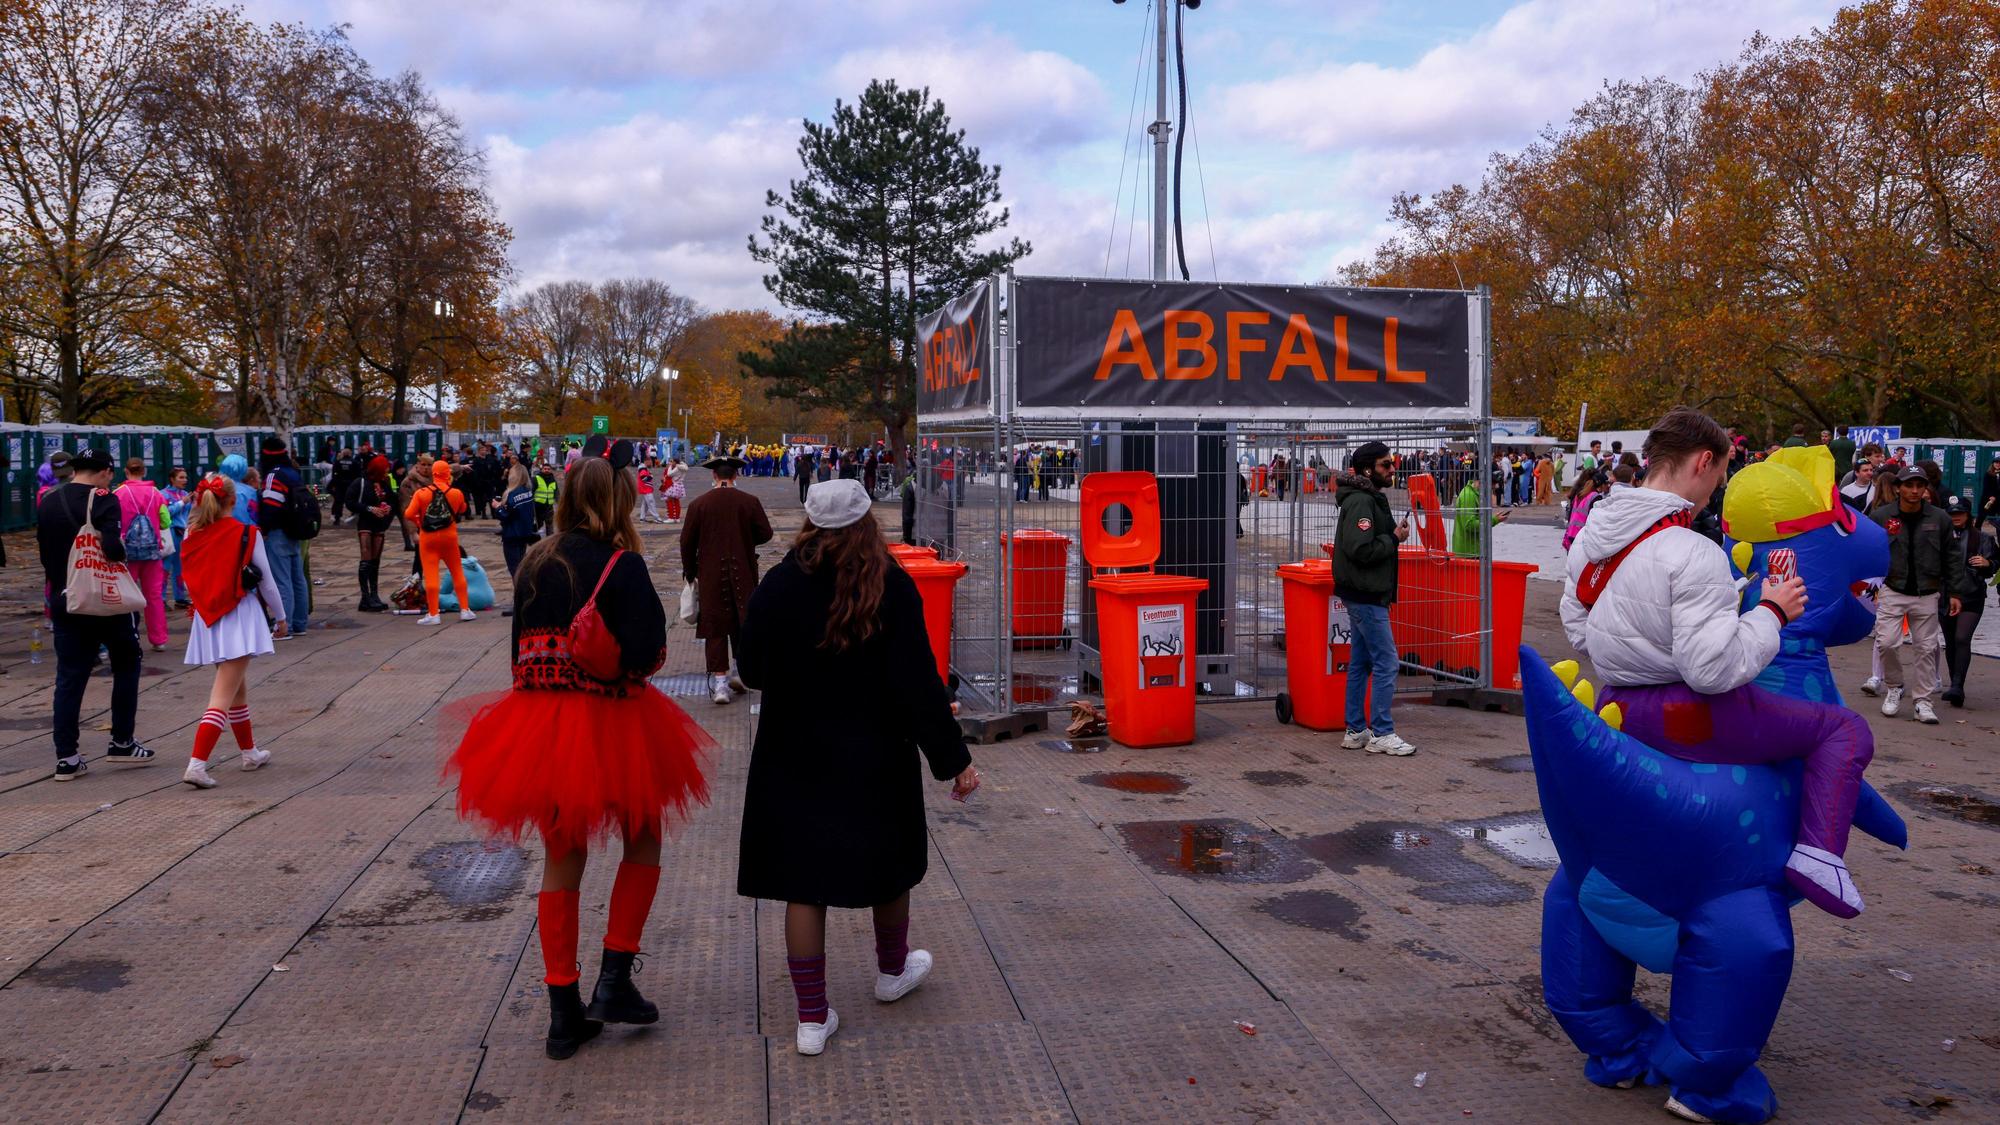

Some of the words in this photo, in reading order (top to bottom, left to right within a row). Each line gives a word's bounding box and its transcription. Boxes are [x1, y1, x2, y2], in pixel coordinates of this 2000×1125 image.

[924, 315, 980, 392] ABFALL
[1093, 309, 1427, 384] ABFALL
[1854, 428, 1880, 446] WC
[1143, 609, 1178, 621] Eventtonne
